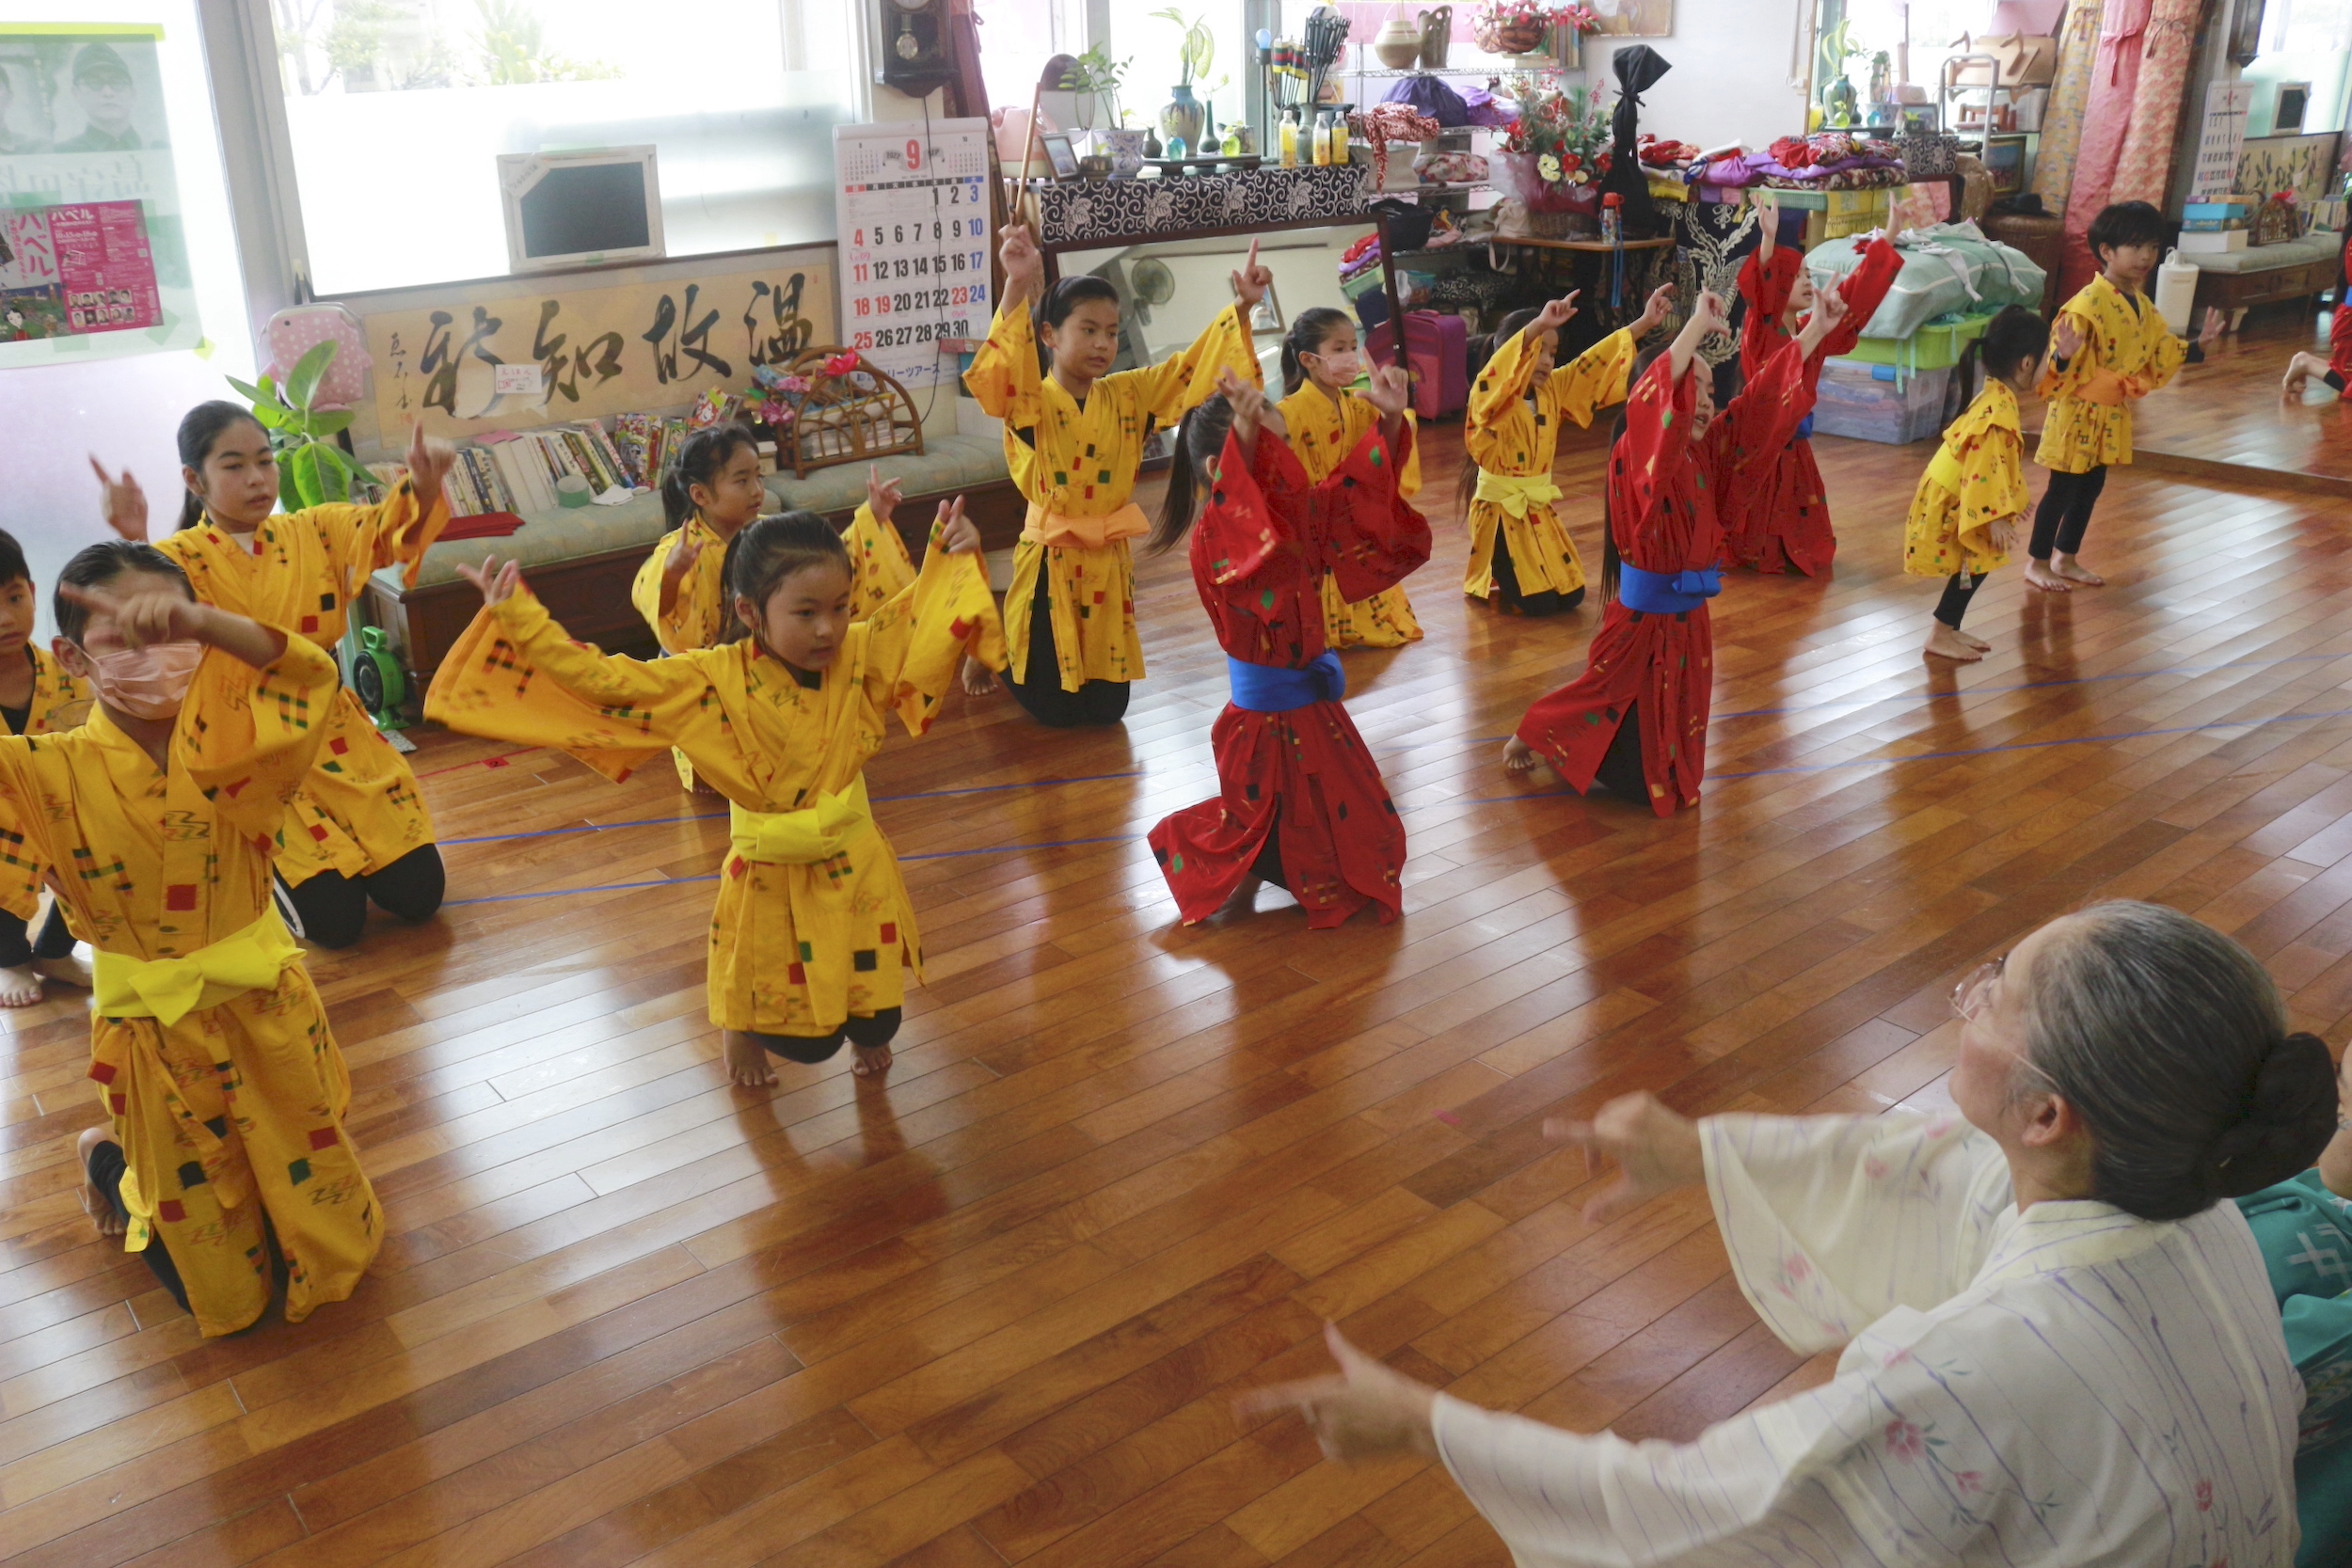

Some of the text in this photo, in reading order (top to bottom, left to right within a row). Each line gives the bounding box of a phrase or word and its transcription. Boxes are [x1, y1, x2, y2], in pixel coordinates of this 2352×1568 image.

[886, 151, 901, 160] 2022
[906, 139, 920, 169] 9
[932, 188, 939, 205] 1
[951, 186, 960, 204] 2
[970, 184, 978, 202] 3
[854, 218, 983, 246] 4 5 6 7 8 9 10
[853, 251, 983, 281] 11 12 13 14 15 16 17
[854, 284, 985, 316] 18 19 20 21 22 23 24
[854, 320, 969, 350] 25 26 27 28 29 30
